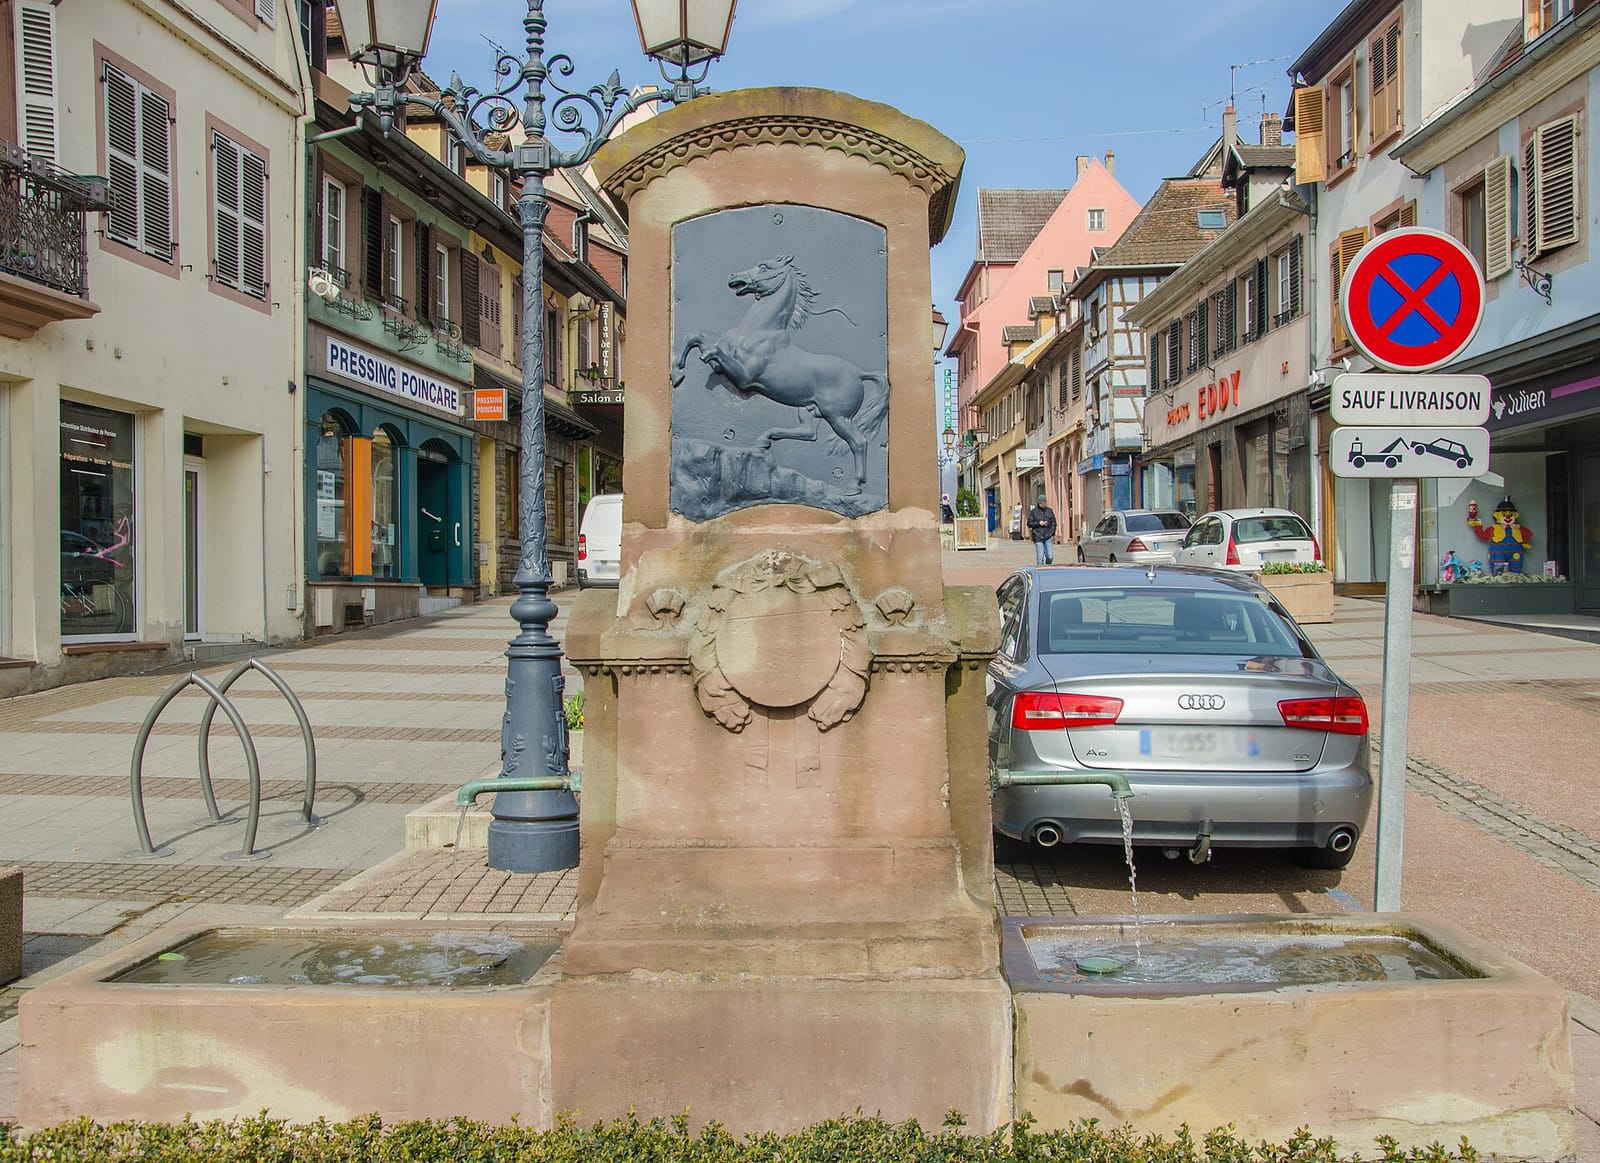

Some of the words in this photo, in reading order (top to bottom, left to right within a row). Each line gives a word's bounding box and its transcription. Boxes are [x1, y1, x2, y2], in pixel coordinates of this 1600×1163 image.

[330, 343, 396, 389] PRESSING
[402, 371, 457, 410] POINCARE
[477, 396, 503, 404] PRESSING
[580, 393, 610, 403] Salon
[1198, 370, 1241, 420] EDDY
[1342, 390, 1386, 409] SAUF
[1390, 390, 1481, 410] LIVRAISON
[1508, 389, 1546, 415] Julien
